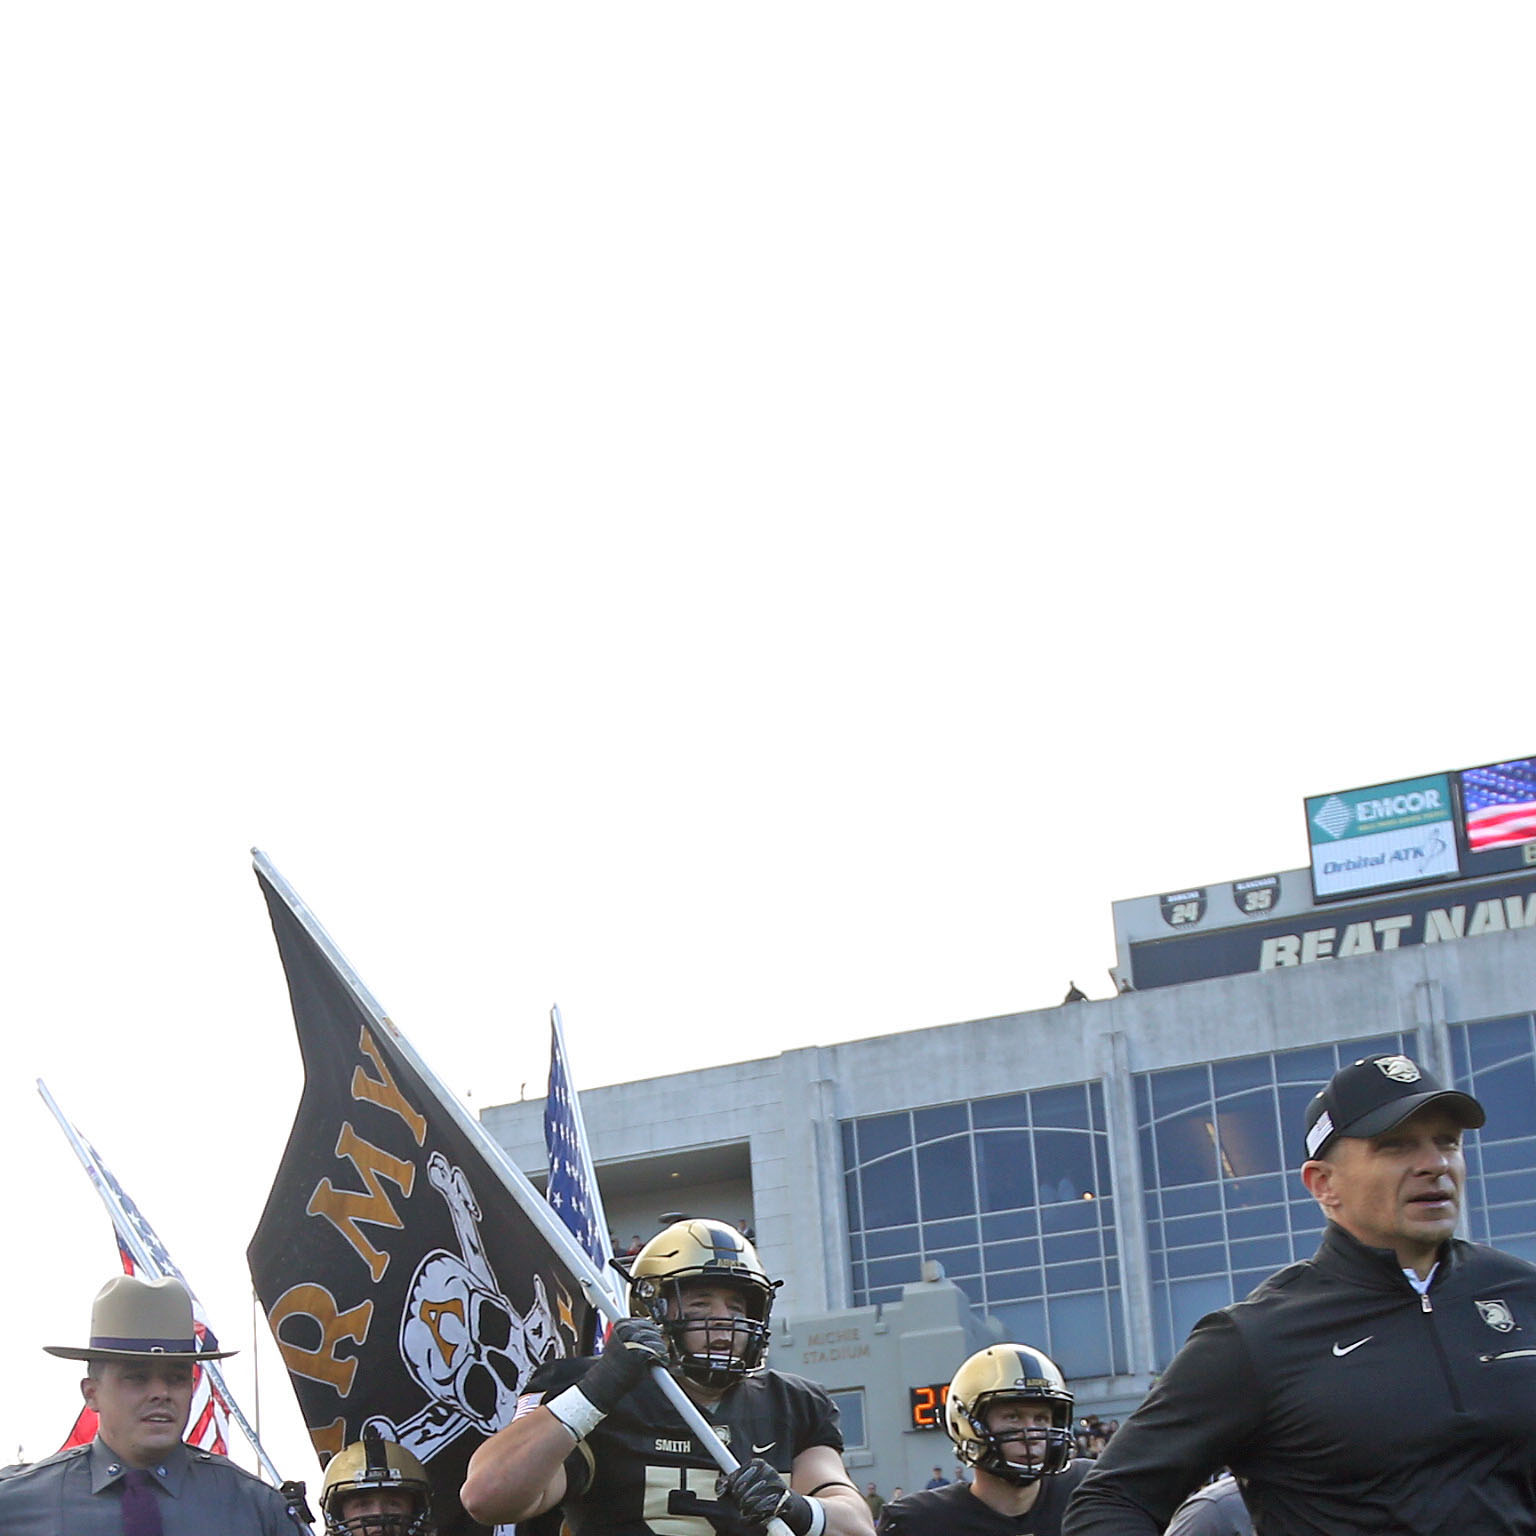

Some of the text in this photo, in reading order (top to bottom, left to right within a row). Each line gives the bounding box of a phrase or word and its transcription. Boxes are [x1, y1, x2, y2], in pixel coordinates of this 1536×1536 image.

[1355, 787, 1442, 822] EMCOR
[1322, 846, 1424, 875] Orbital ATK
[1244, 889, 1272, 911] 35
[1171, 901, 1199, 924] 24
[1259, 914, 1413, 971] BEAT
[807, 1328, 861, 1346] MICHIE
[802, 1344, 871, 1364] STADIUM
[654, 1438, 691, 1453] SMITH
